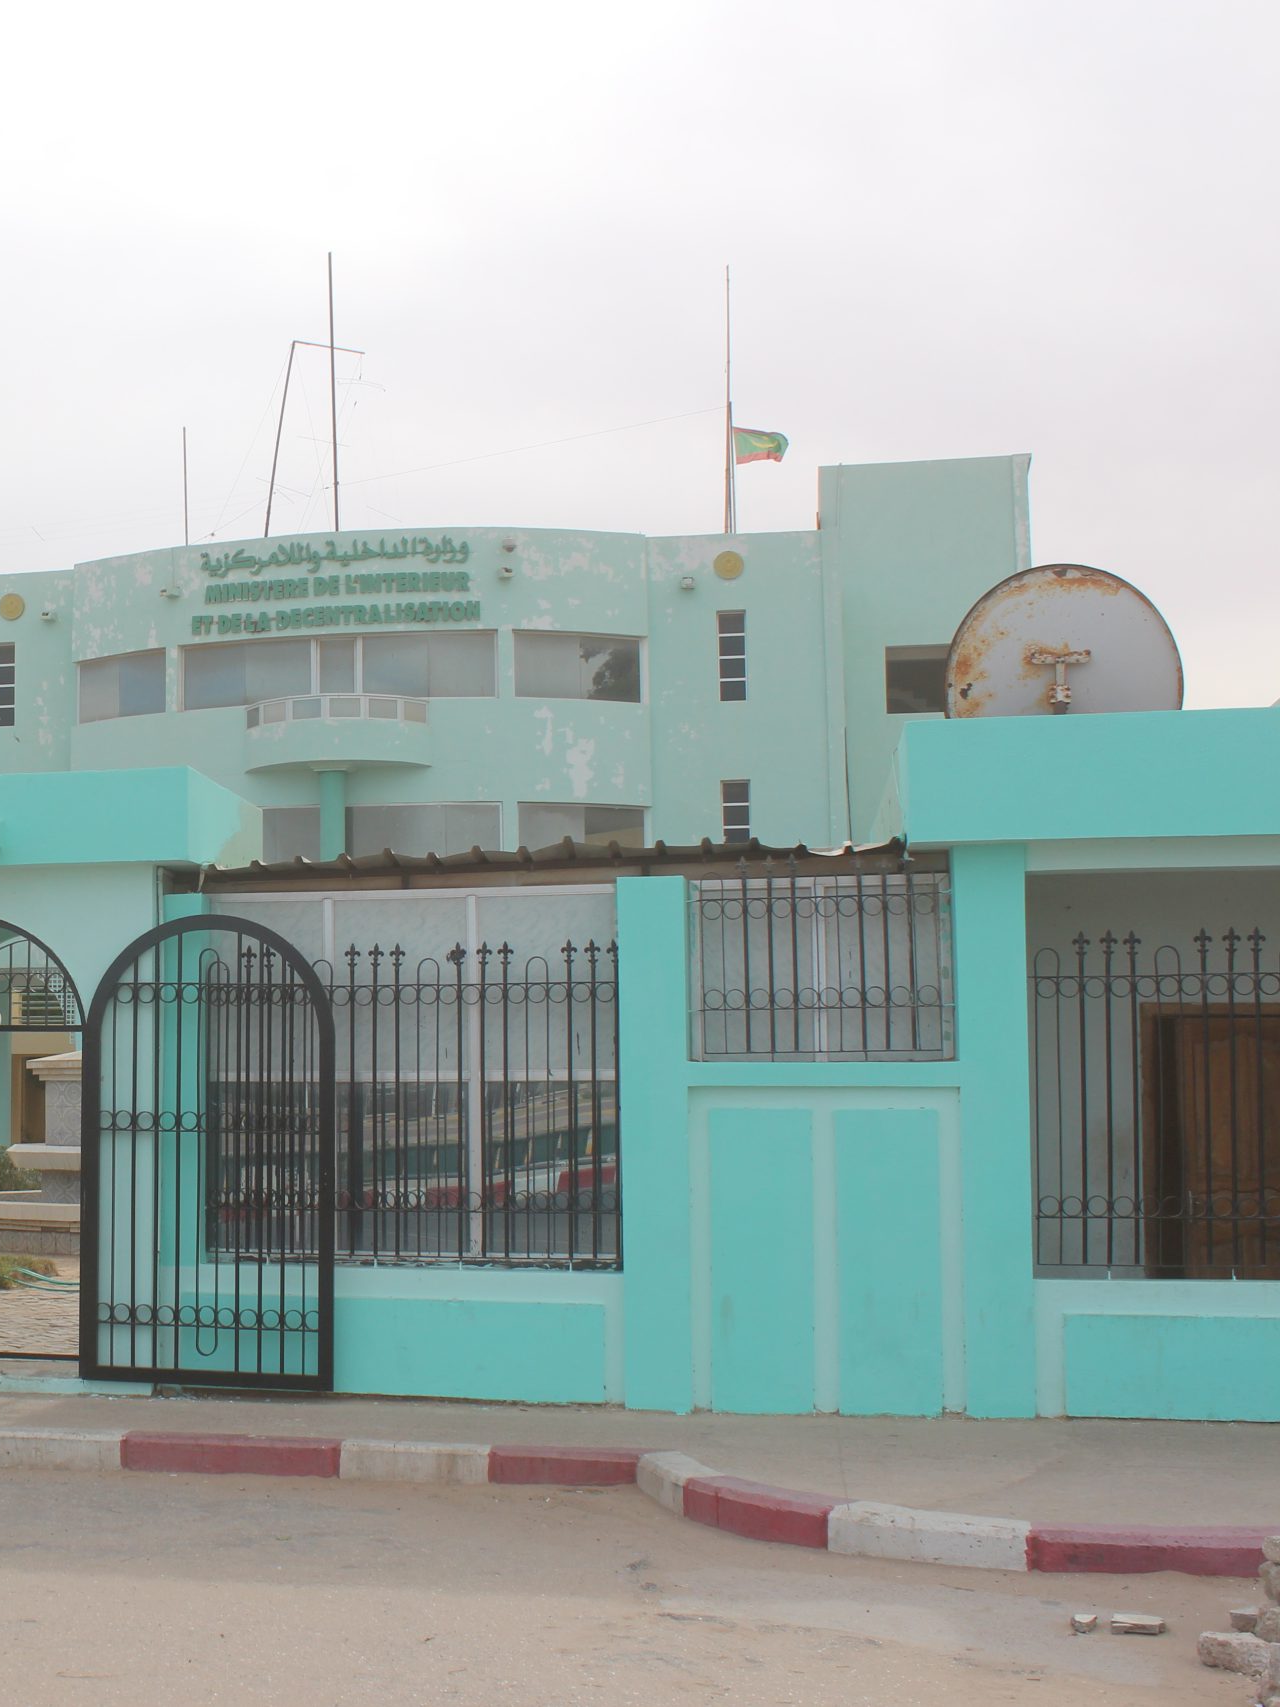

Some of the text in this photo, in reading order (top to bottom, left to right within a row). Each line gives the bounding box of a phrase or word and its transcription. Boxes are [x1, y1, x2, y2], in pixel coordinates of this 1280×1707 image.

[325, 536, 418, 567] الداخلية
[418, 534, 470, 564] وزارة
[204, 571, 470, 605] MINISTERE DE L'INTERIEUR
[191, 600, 481, 636] ET DE LA DECENTRALISATION
